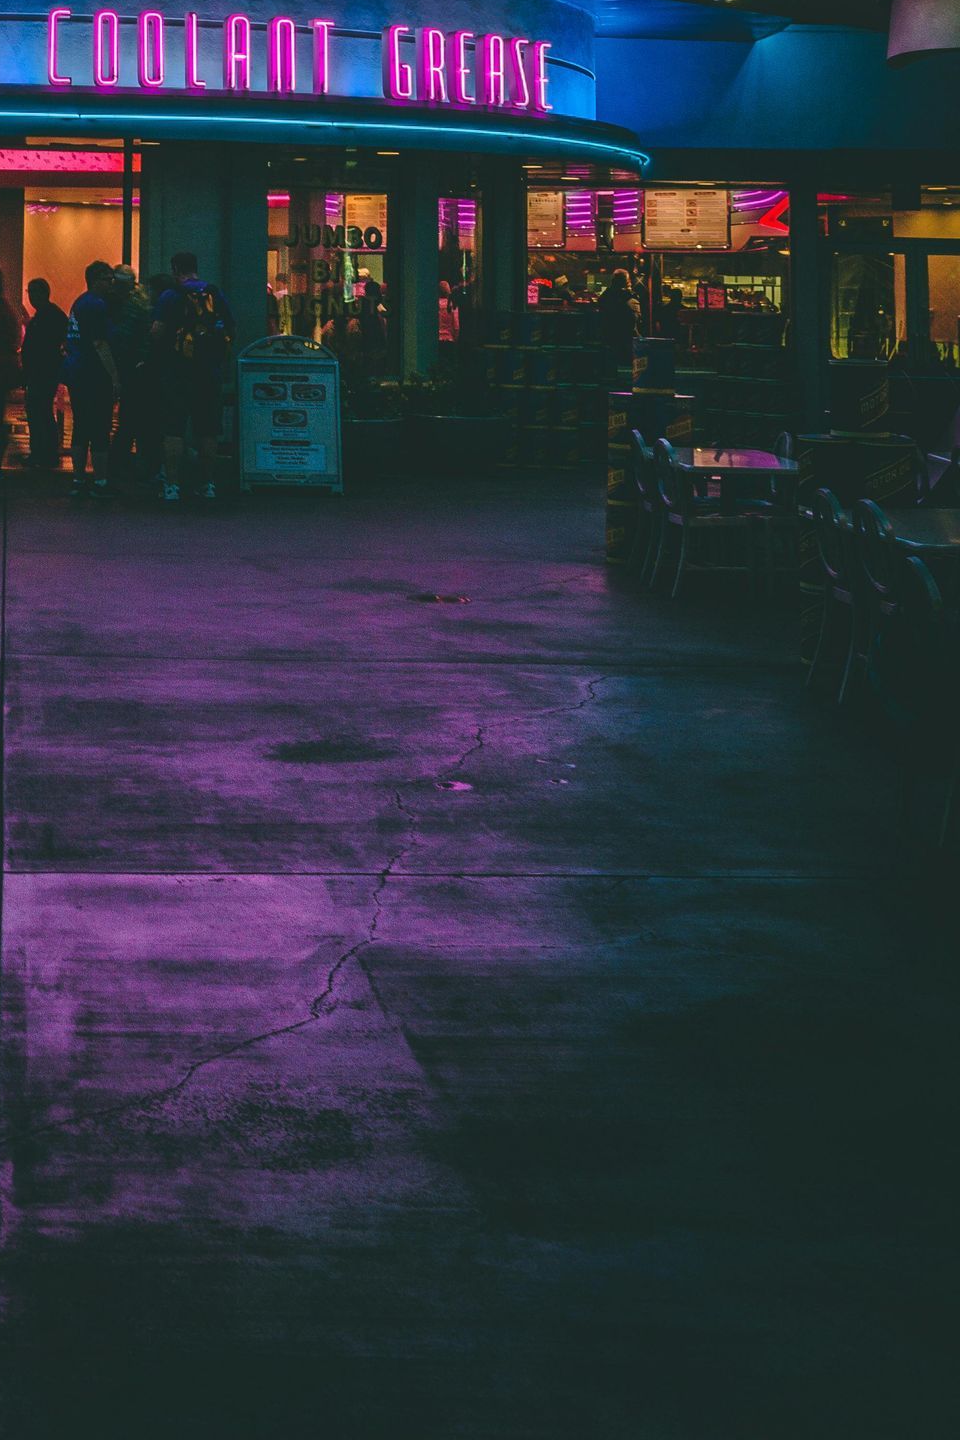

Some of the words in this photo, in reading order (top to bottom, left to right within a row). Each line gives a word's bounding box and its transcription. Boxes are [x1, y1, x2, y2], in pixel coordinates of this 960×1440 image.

[46, 7, 335, 94] COOLANT
[387, 24, 554, 112] GREASE
[285, 223, 383, 250] JUMBO
